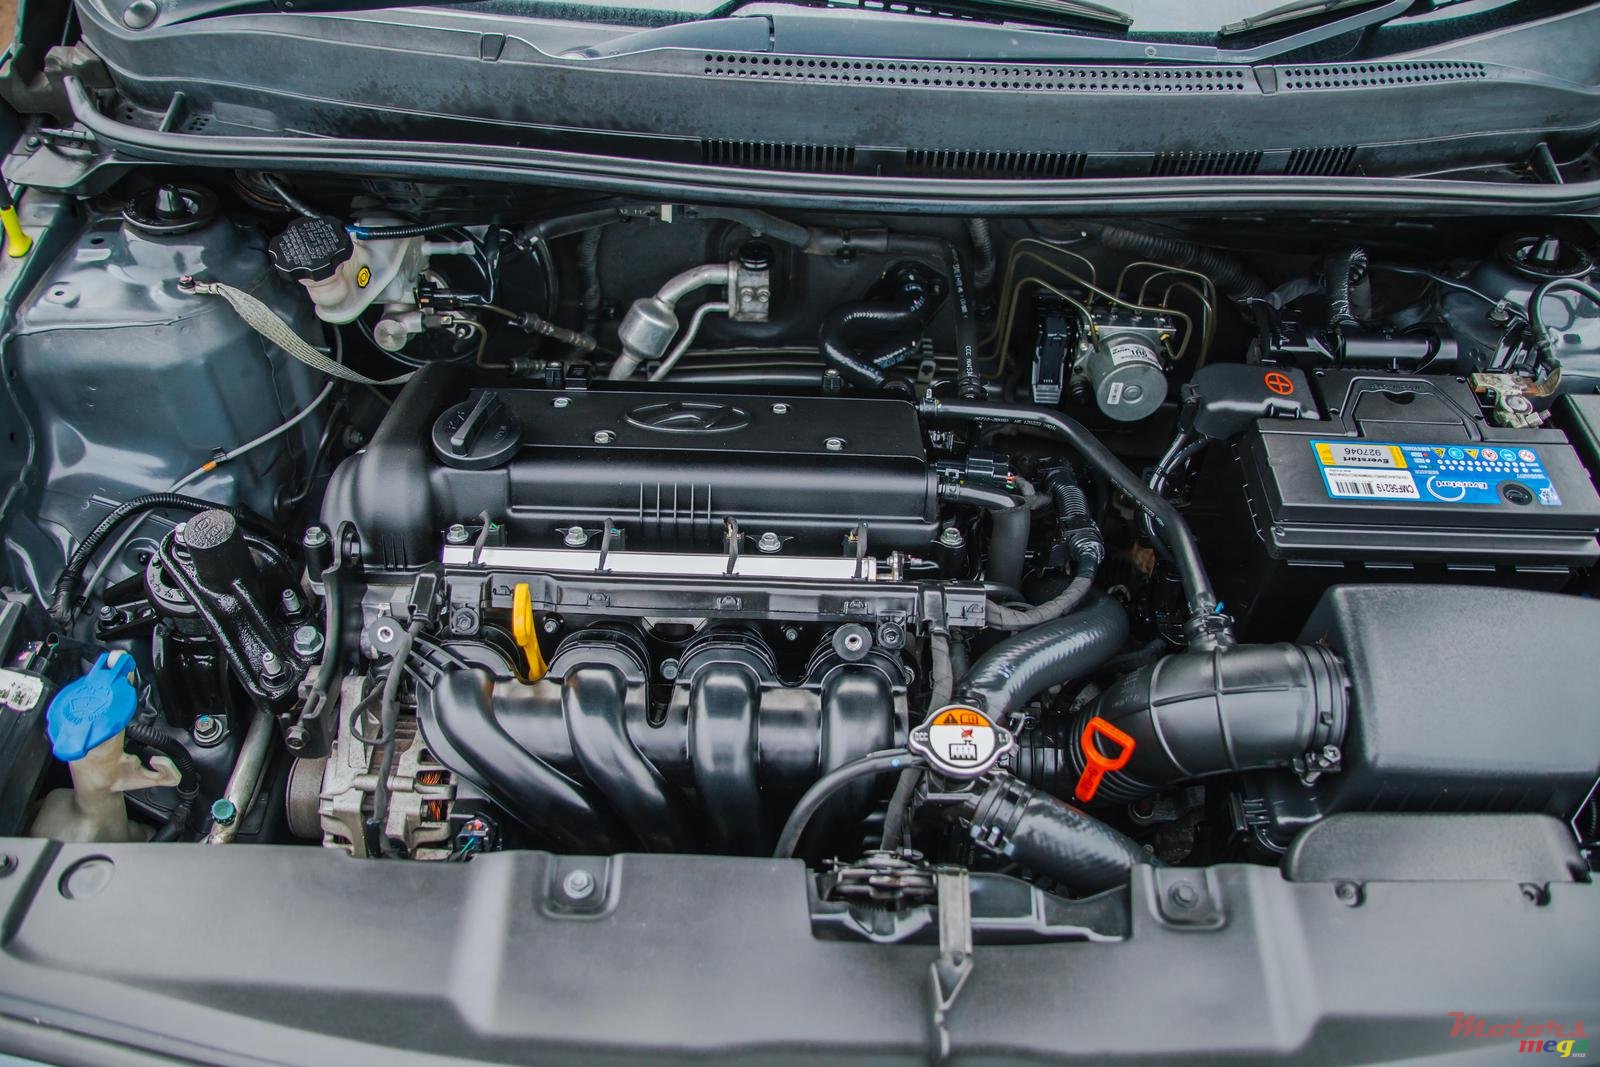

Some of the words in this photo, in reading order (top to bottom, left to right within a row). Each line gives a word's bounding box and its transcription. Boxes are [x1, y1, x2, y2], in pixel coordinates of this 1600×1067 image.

[1344, 447, 1382, 457] 927046
[1343, 456, 1390, 464] Everstart
[1376, 483, 1415, 494] CMF56219
[1436, 480, 1488, 490] Everstart
